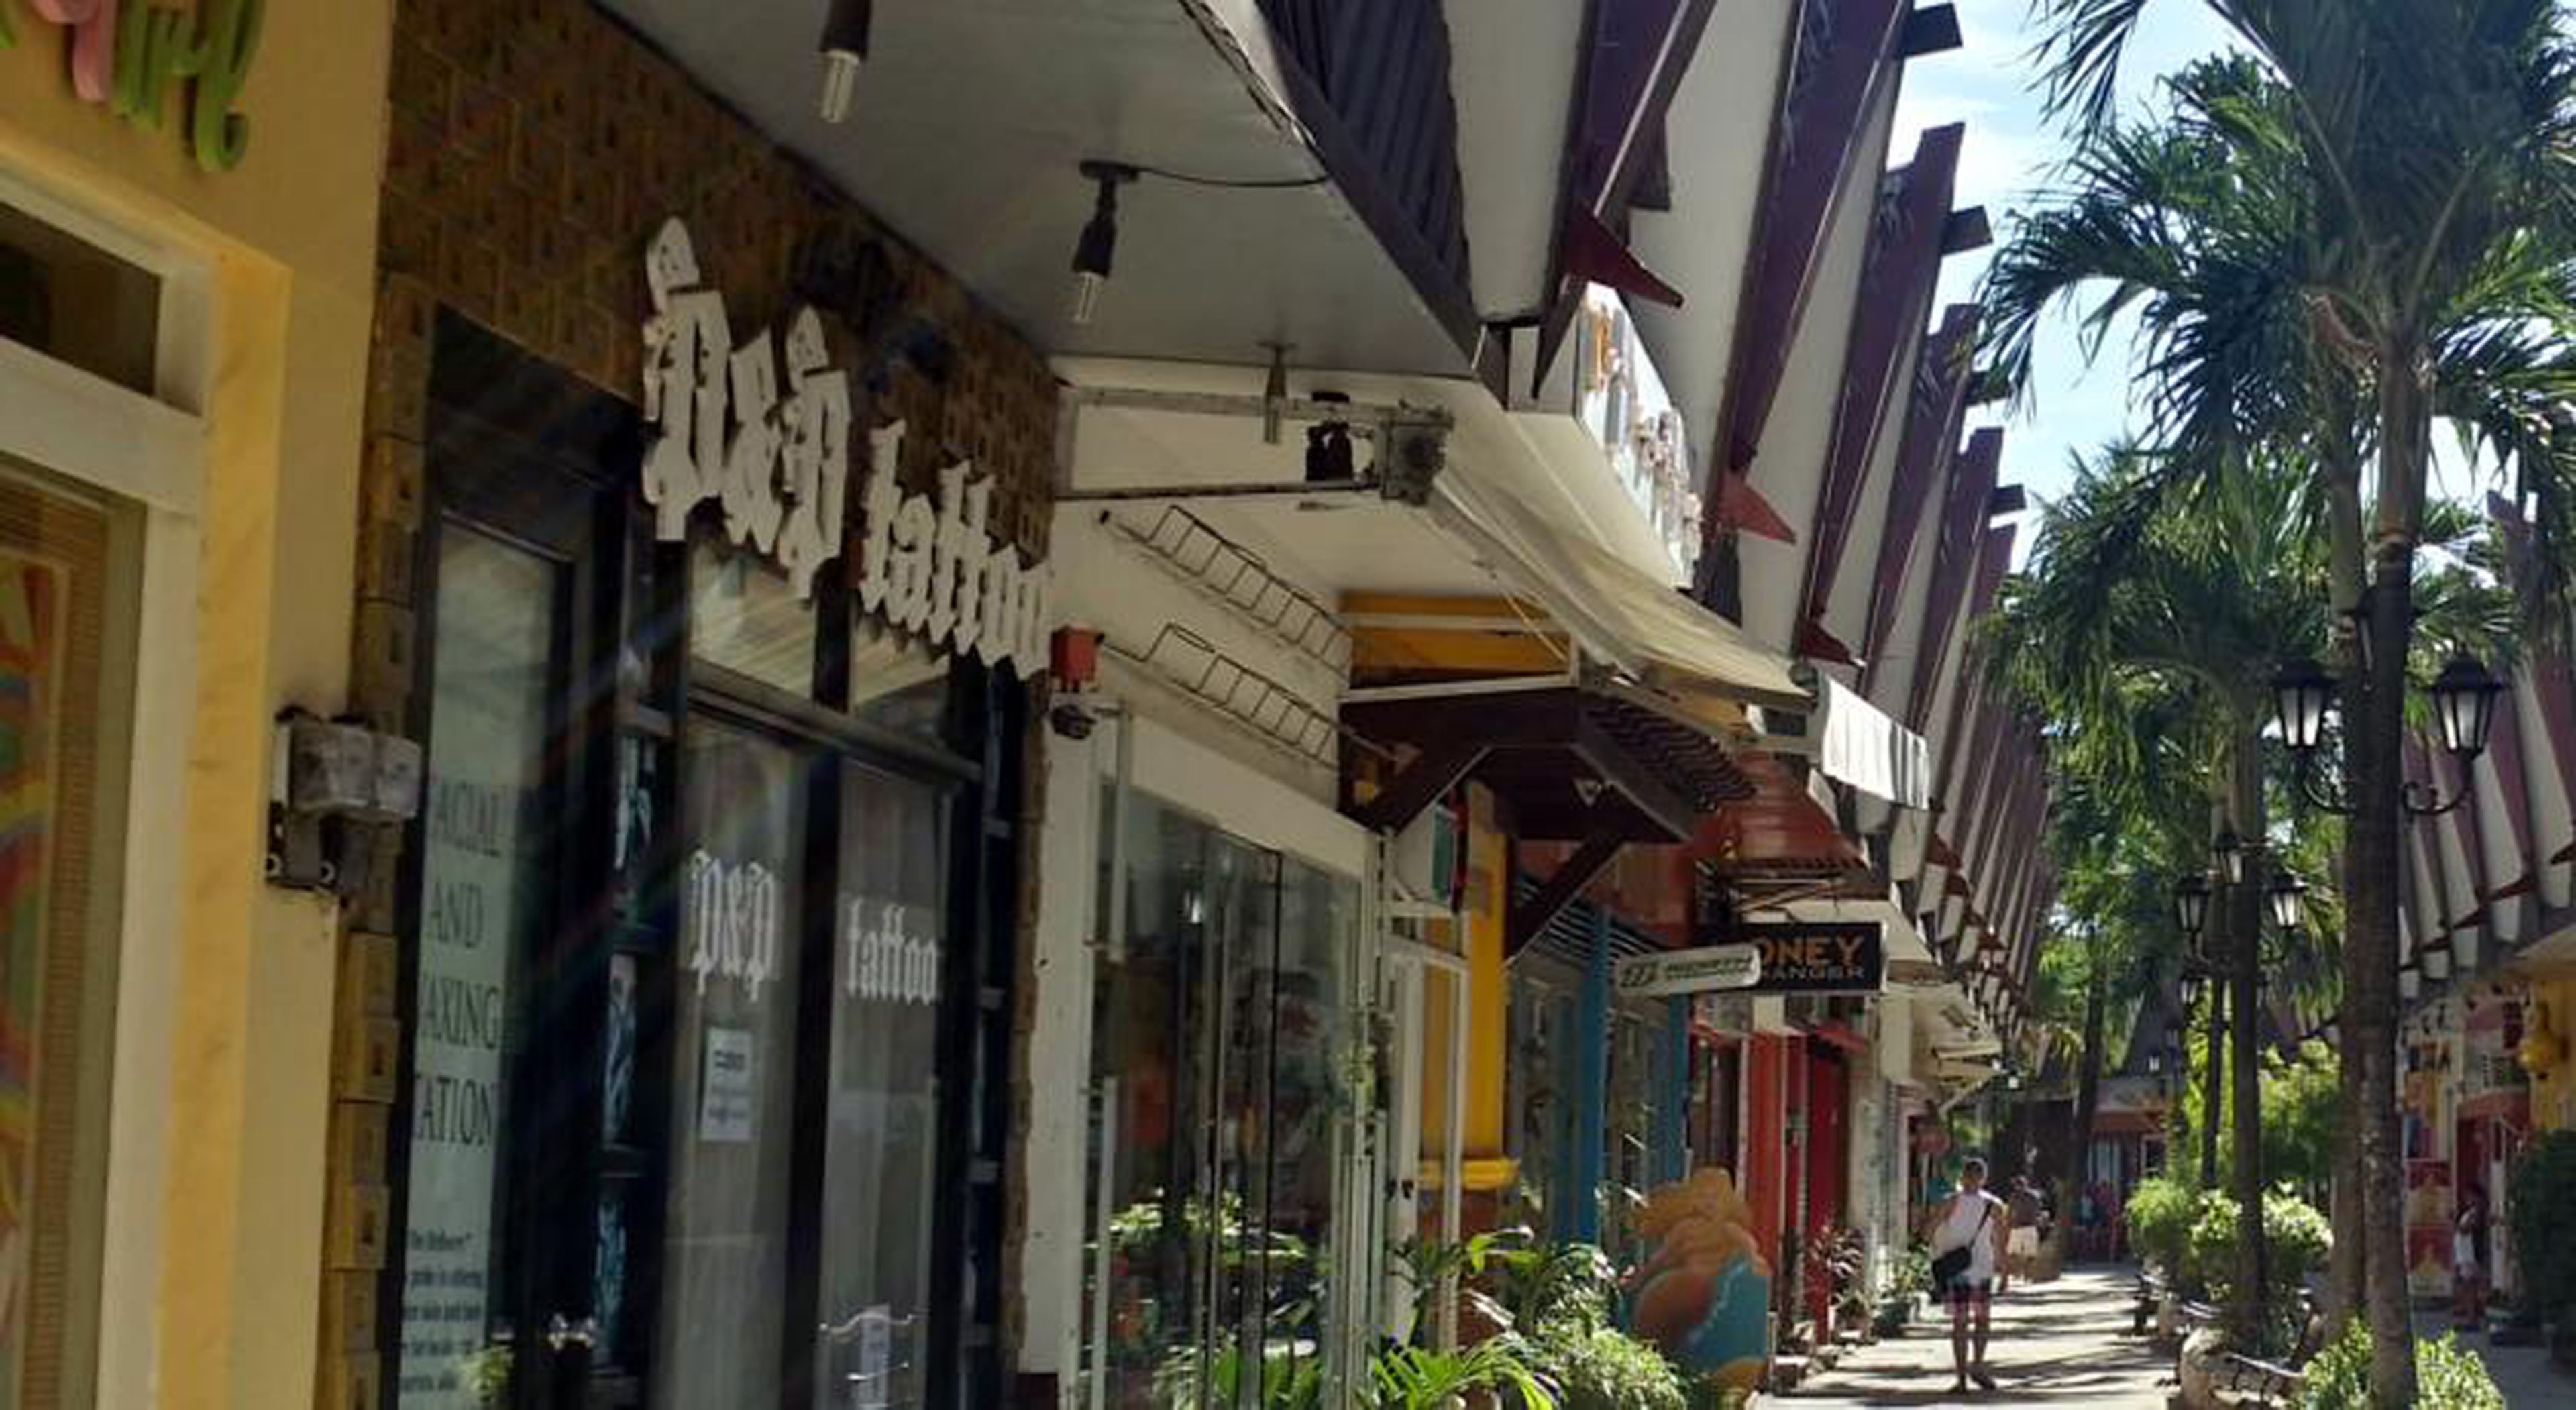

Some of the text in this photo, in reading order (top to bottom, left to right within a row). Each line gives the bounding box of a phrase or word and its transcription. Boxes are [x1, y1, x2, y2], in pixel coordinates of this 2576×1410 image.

[427, 877, 484, 949] AND
[419, 971, 501, 1050] AXING
[415, 1073, 499, 1146] ATION
